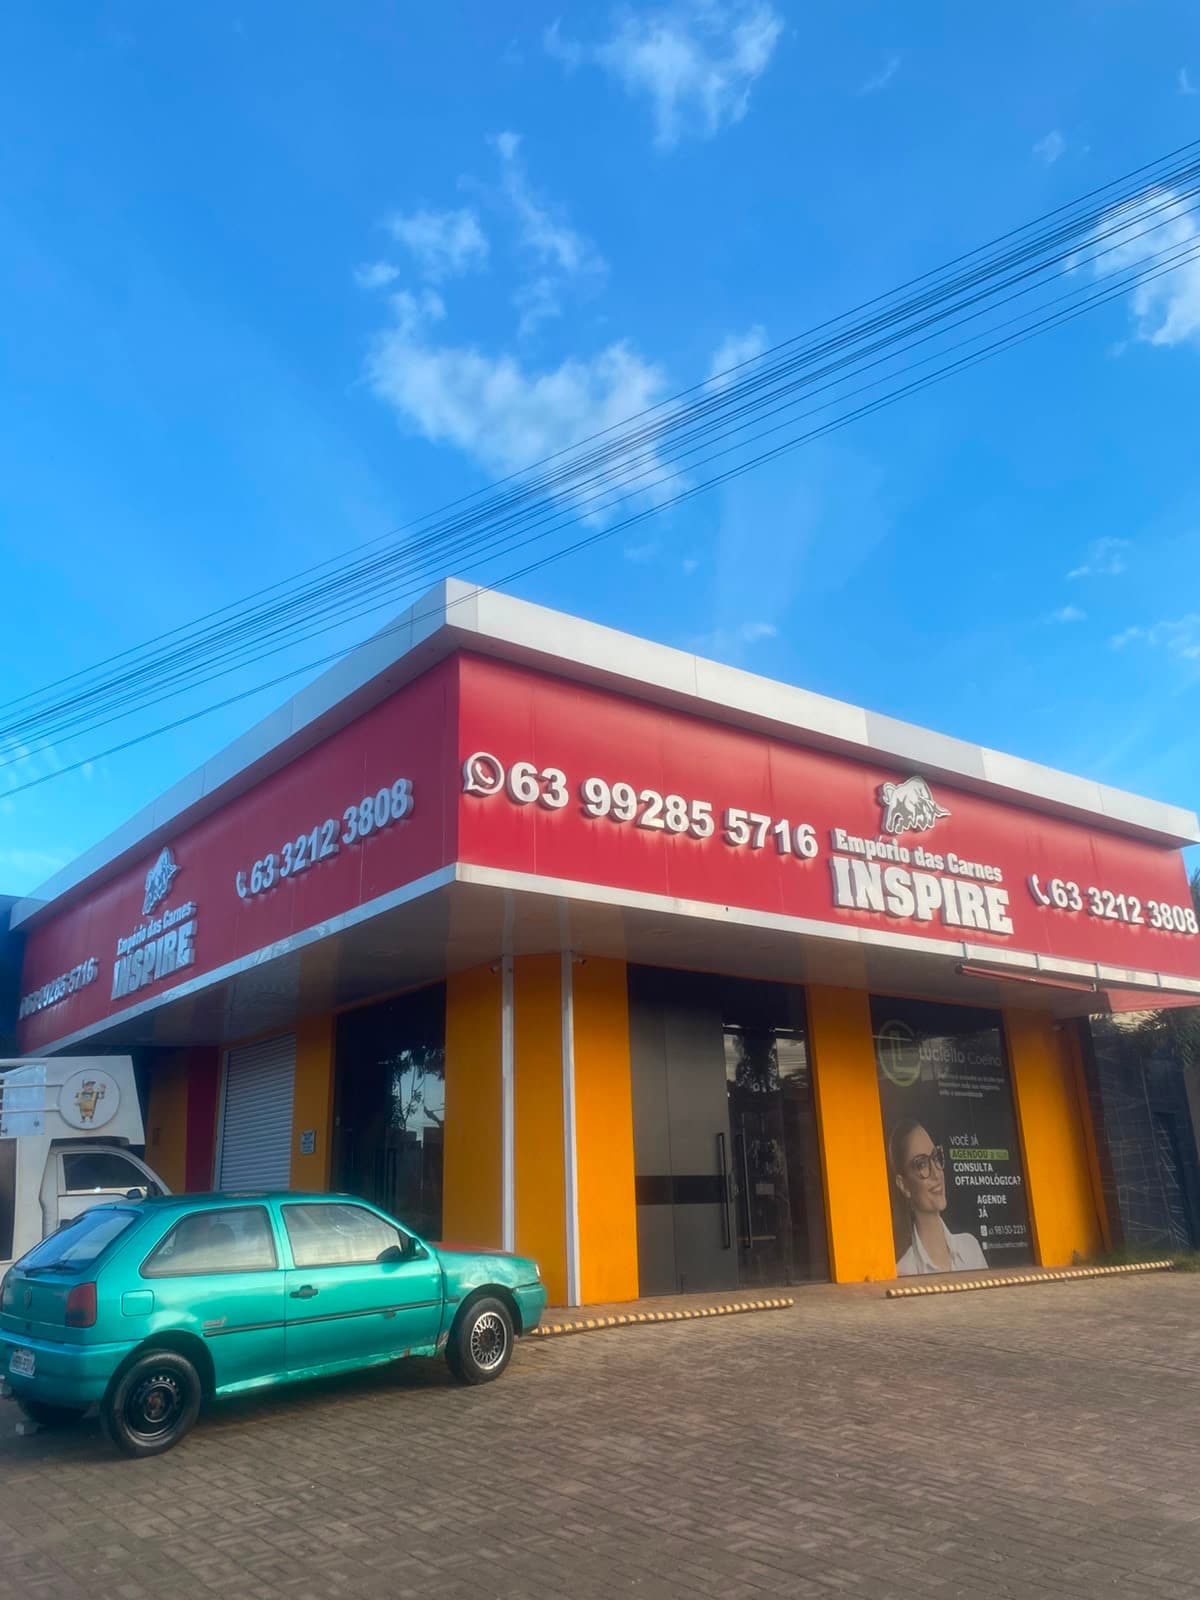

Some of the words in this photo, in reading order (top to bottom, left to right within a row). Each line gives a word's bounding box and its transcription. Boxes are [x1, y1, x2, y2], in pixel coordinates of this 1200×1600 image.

[508, 762, 569, 809] 63
[581, 777, 715, 839] 99285
[725, 808, 819, 858] 5716
[251, 853, 280, 893] 63
[280, 819, 340, 877] 3212
[342, 778, 414, 843] 3808
[831, 828, 911, 865] Empório
[914, 847, 944, 871] das
[947, 853, 1003, 883] Carnes
[831, 856, 1014, 935] INSPIRE
[1049, 878, 1083, 911] 63
[1087, 887, 1145, 924] 3212
[1147, 900, 1200, 934] 3808
[111, 920, 198, 1001] INSPIRE
[950, 1132, 969, 1146] VOCÊ
[952, 1150, 989, 1159] AGENDOU
[953, 1162, 994, 1173] CONSULTA
[955, 1173, 1022, 1186] OFTALMOLÓGICA?
[977, 1194, 1007, 1205] AGENDE
[978, 1205, 989, 1218] JÁ
